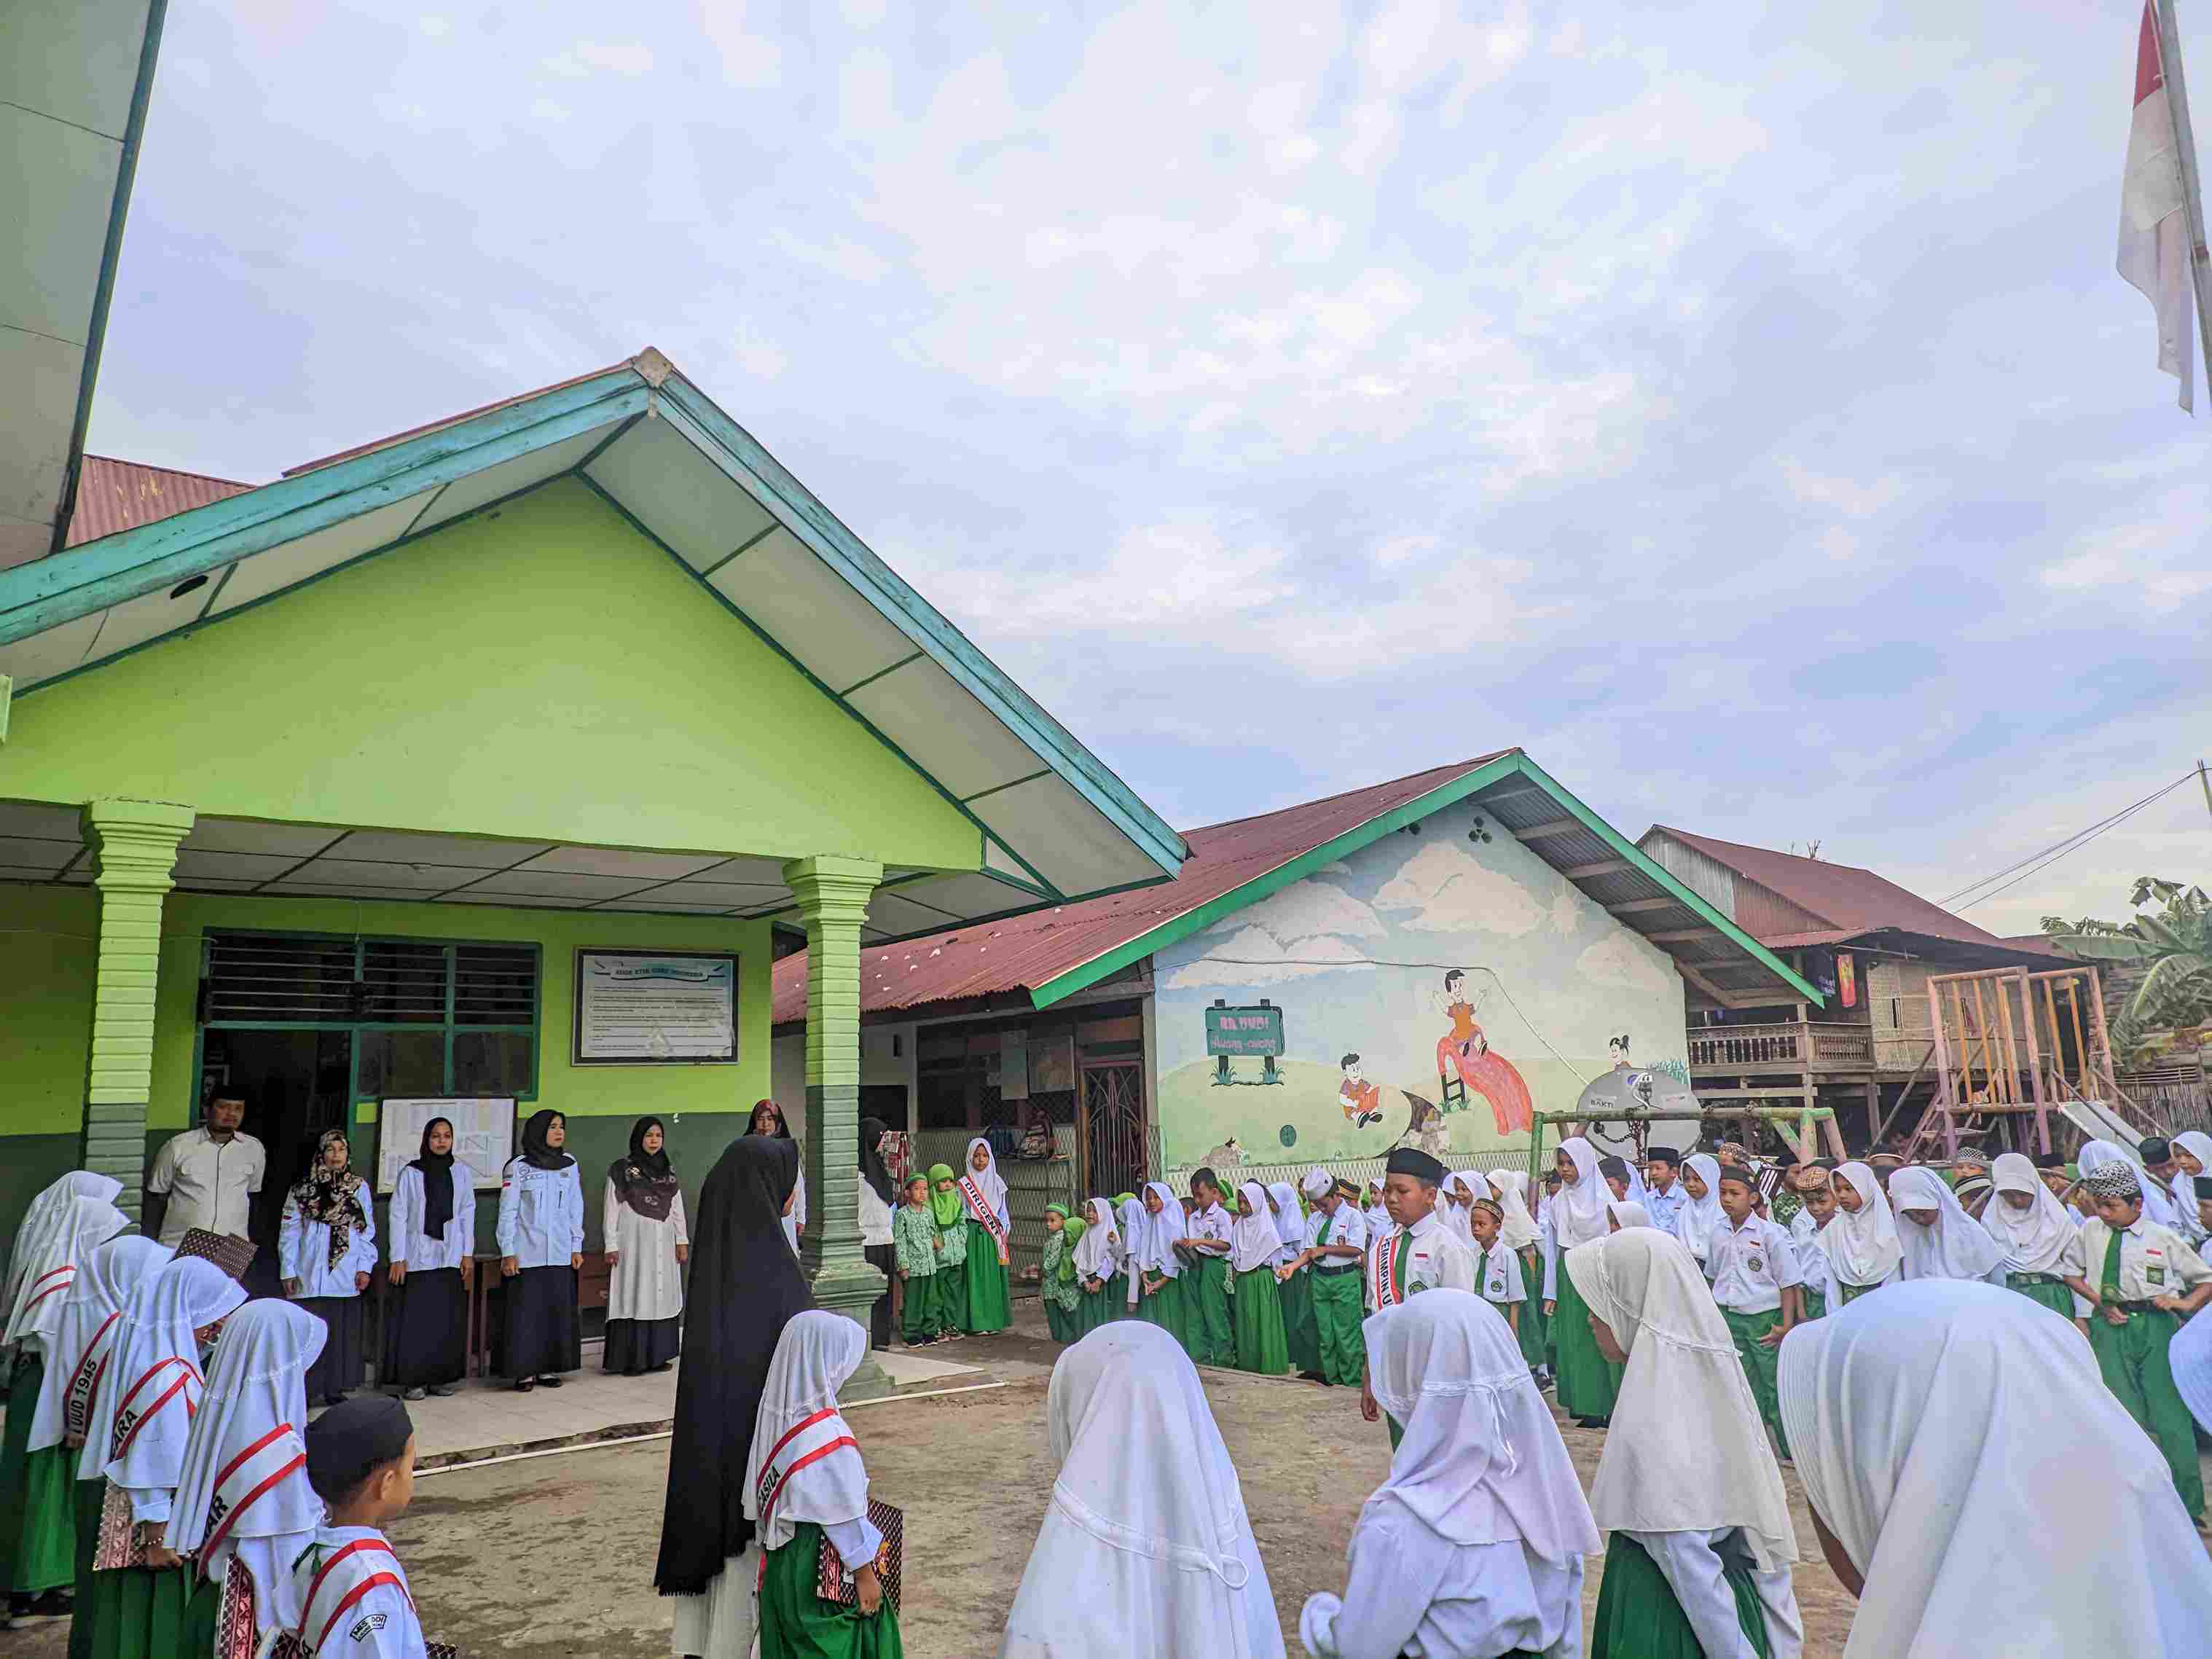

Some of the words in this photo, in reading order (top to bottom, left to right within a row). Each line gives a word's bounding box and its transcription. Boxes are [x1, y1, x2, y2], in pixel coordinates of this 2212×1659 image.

[965, 1182, 999, 1236] DIRIGENT
[75, 1359, 97, 1395] 1945
[114, 1409, 138, 1451] ARA
